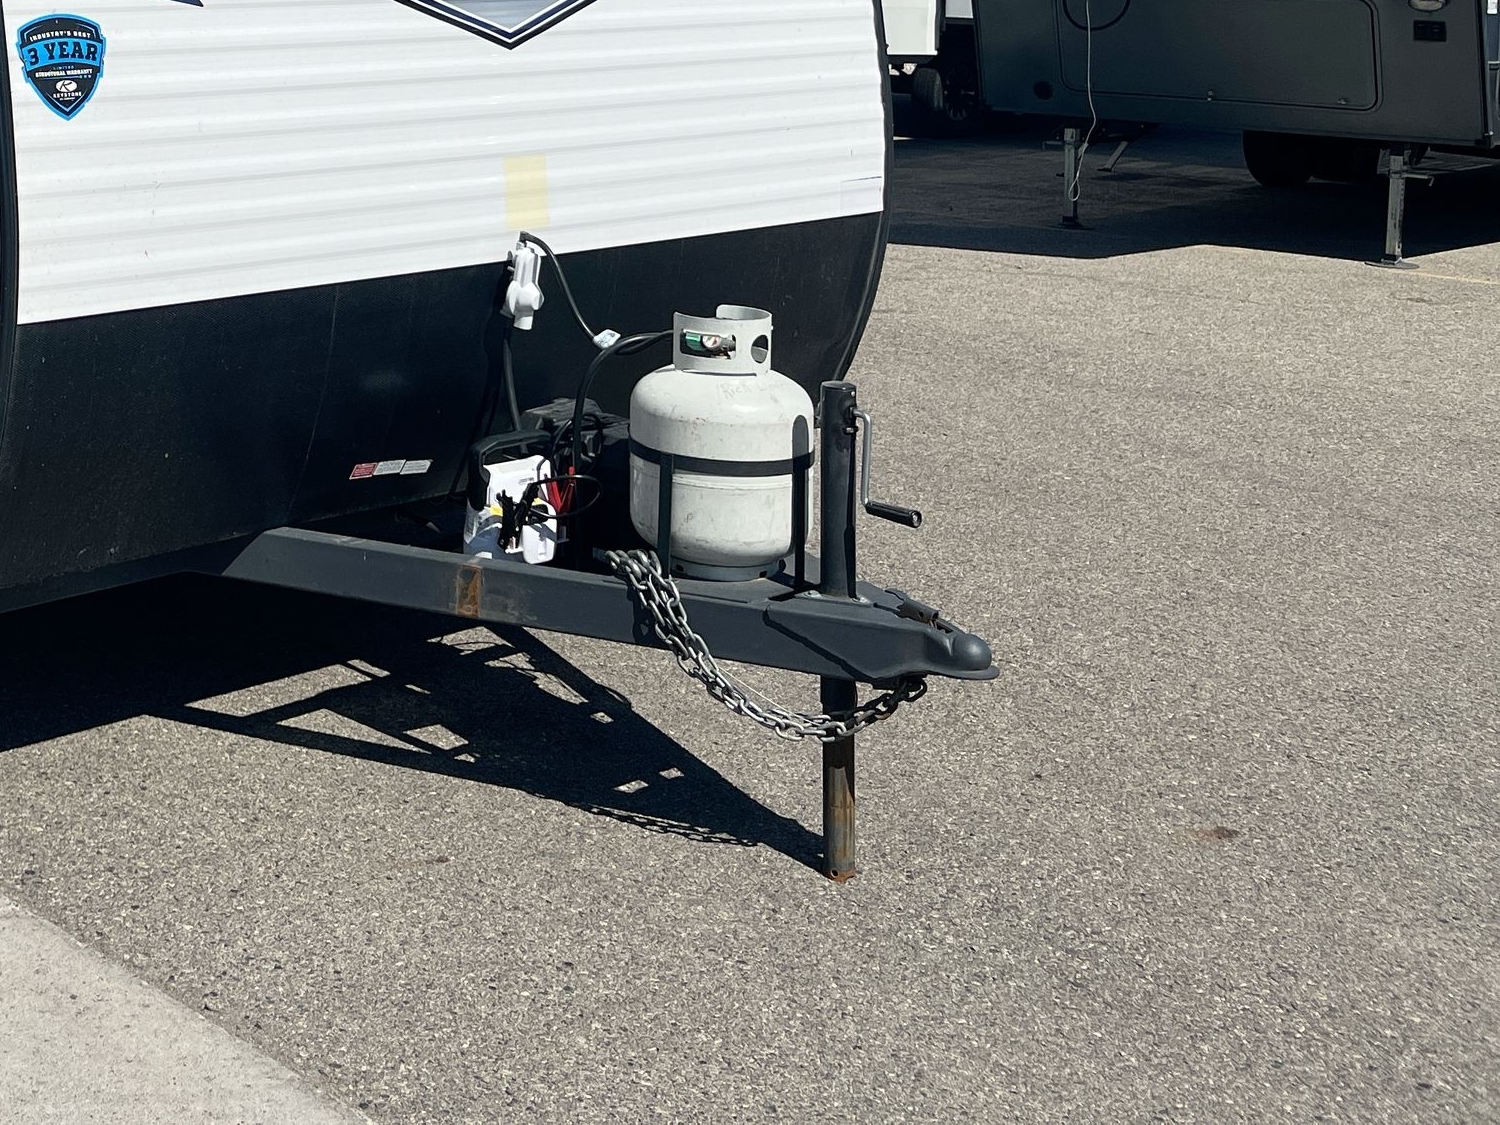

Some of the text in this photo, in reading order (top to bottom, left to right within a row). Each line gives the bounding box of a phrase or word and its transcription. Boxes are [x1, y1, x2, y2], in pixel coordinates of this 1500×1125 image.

[73, 30, 91, 39] BEST
[27, 41, 98, 66] 3 YEAR
